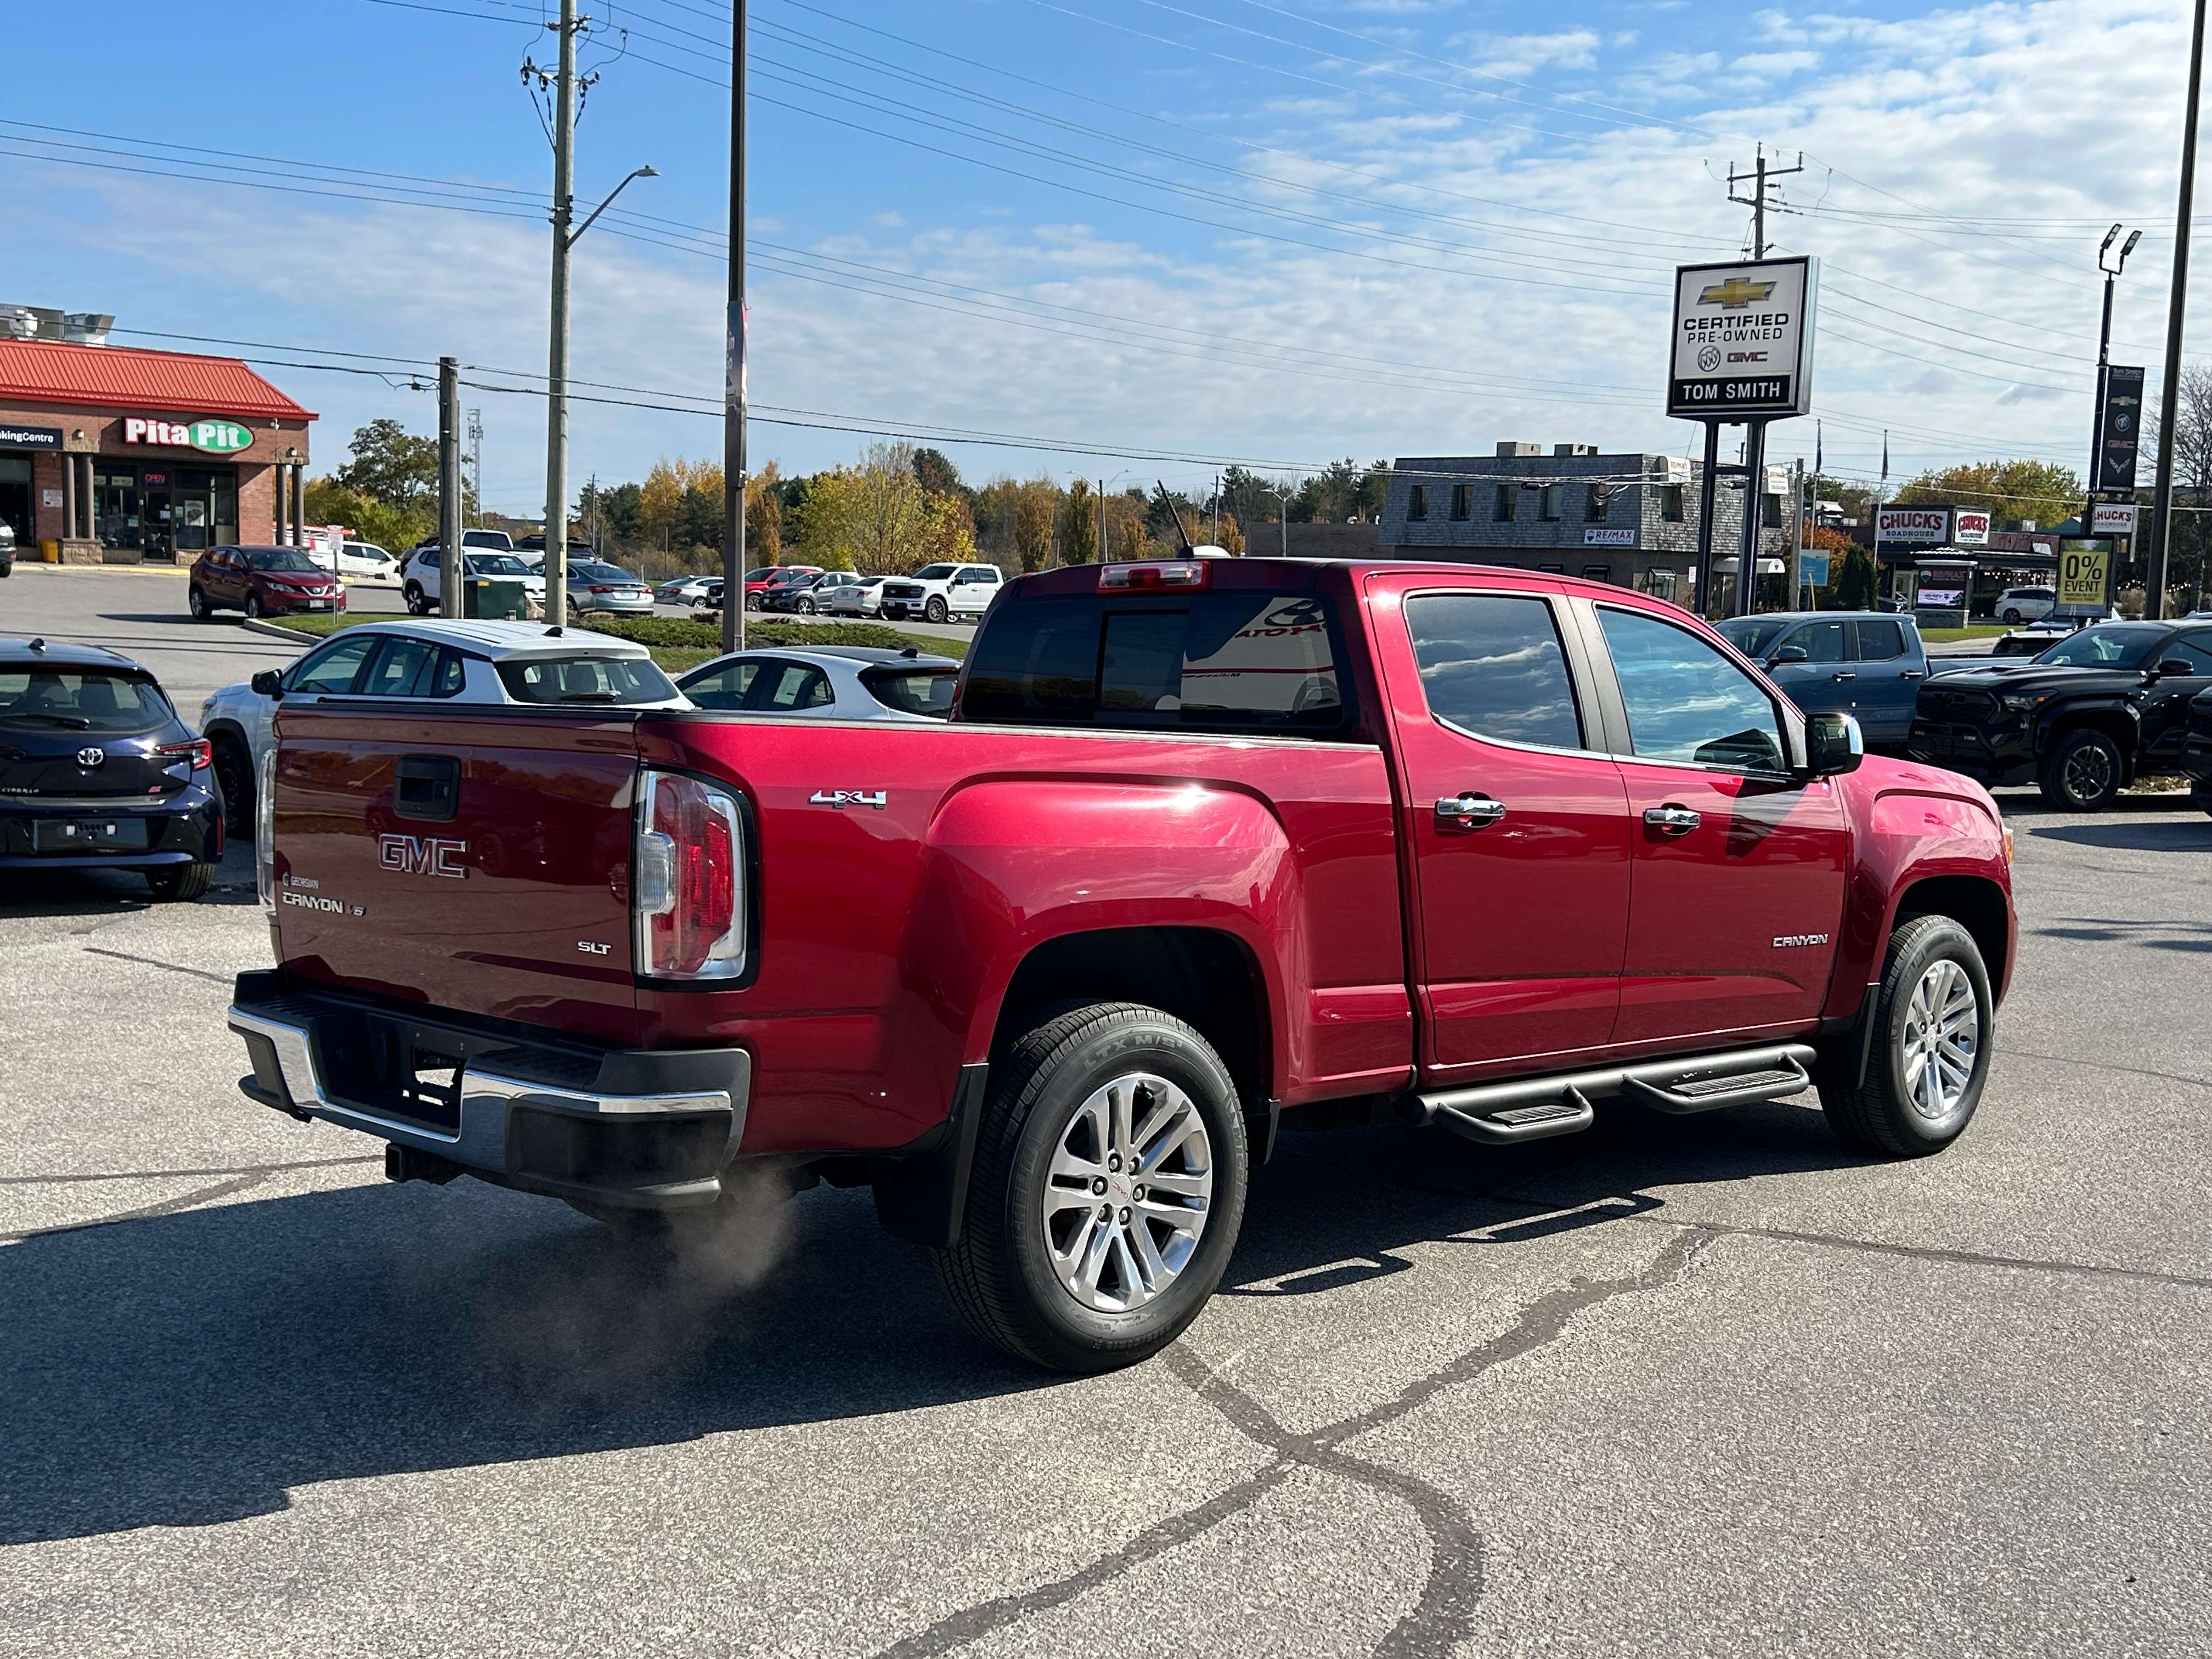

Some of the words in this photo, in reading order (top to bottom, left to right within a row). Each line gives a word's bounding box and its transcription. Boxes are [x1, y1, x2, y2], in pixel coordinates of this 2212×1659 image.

[1684, 313, 1789, 331] CERTIFIED
[1688, 328, 1782, 344] PRE-OWNED
[1727, 351, 1768, 363] GMC
[1683, 383, 1718, 400] TOM
[1725, 381, 1780, 399] SMITH
[126, 418, 189, 444] Pita
[197, 422, 240, 448] Pit
[145, 473, 165, 483] OPEN
[1880, 513, 1943, 531] CHUCK'S
[1596, 531, 1633, 540] RE/MAX
[2066, 555, 2102, 580] 0%
[2064, 580, 2101, 592] EVENT
[379, 833, 466, 879] GMC
[283, 891, 345, 913] CANYON
[578, 940, 612, 955] SLT
[1773, 933, 1829, 947] CANYON
[1082, 1039, 1127, 1070] LTX
